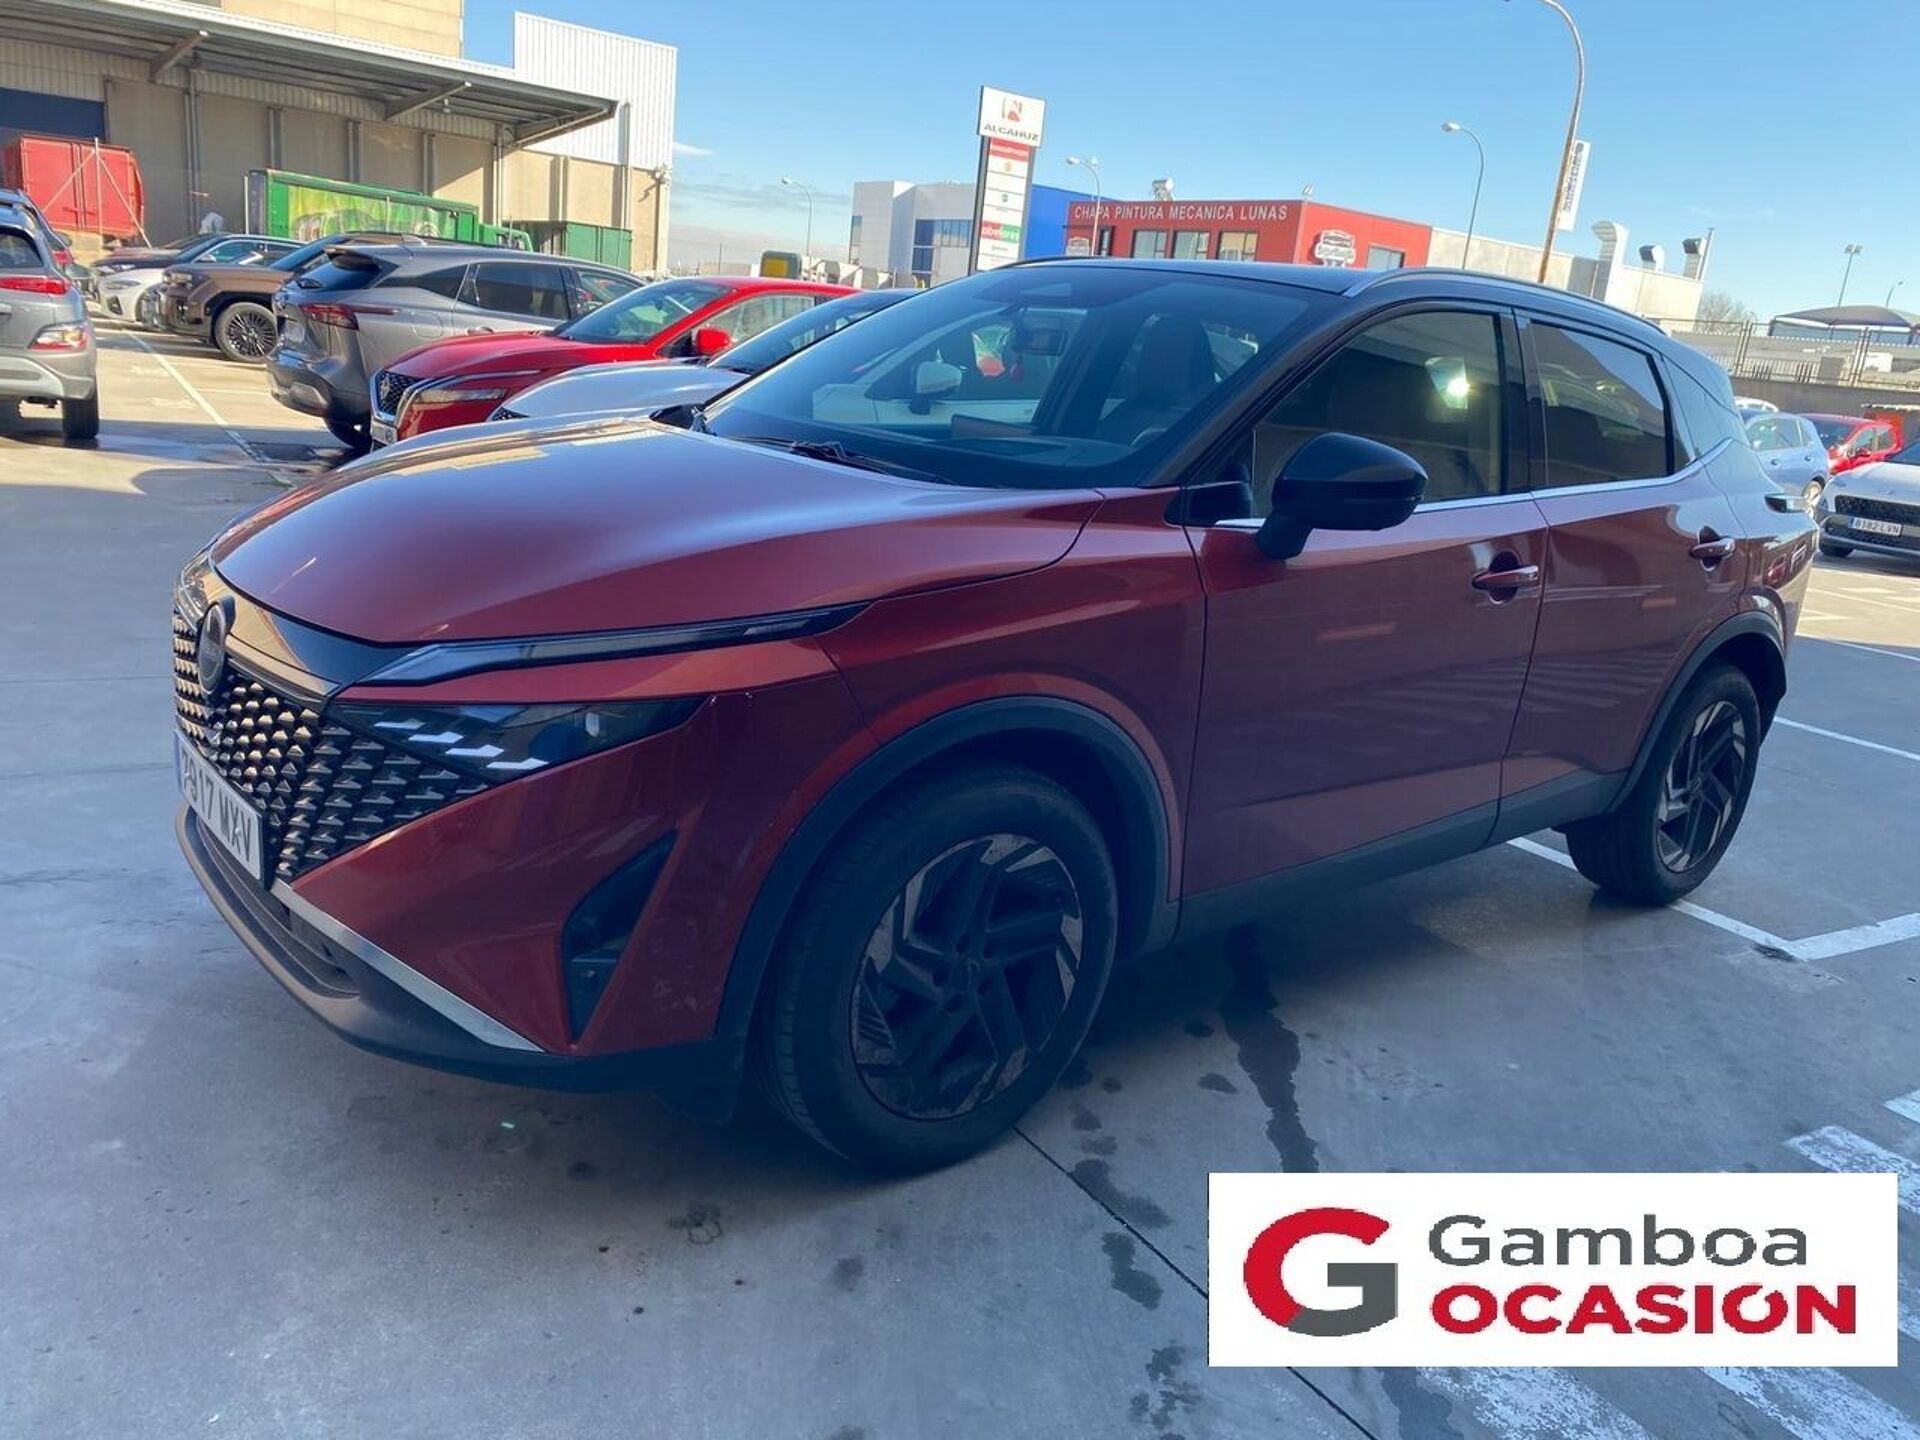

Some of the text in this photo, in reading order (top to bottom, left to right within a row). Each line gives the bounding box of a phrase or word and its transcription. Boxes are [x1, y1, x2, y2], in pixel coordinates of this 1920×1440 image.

[984, 123, 1039, 141] ALCAHUZ
[1075, 204, 1288, 220] CHAPA PINTURA MECANICA LUNAS
